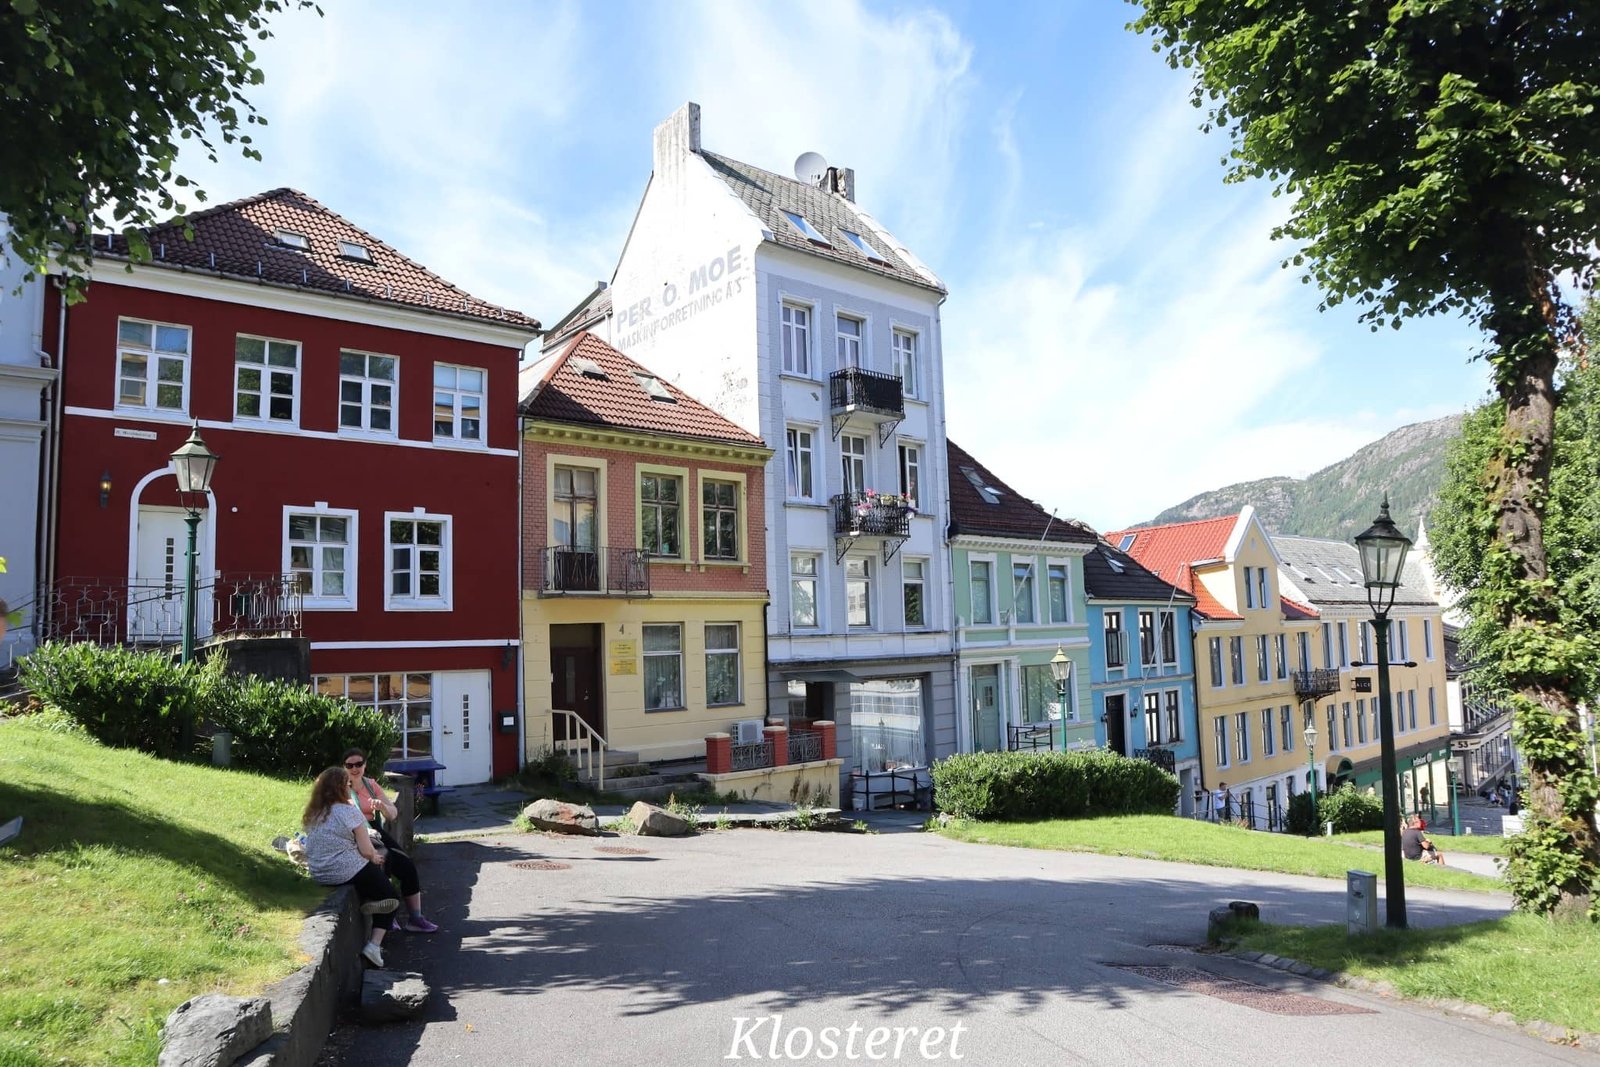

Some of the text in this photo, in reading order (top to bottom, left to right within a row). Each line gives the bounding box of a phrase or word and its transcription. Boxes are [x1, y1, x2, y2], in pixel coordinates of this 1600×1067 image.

[616, 296, 653, 334] PER
[688, 244, 741, 295] MOE
[1457, 740, 1469, 749] 53
